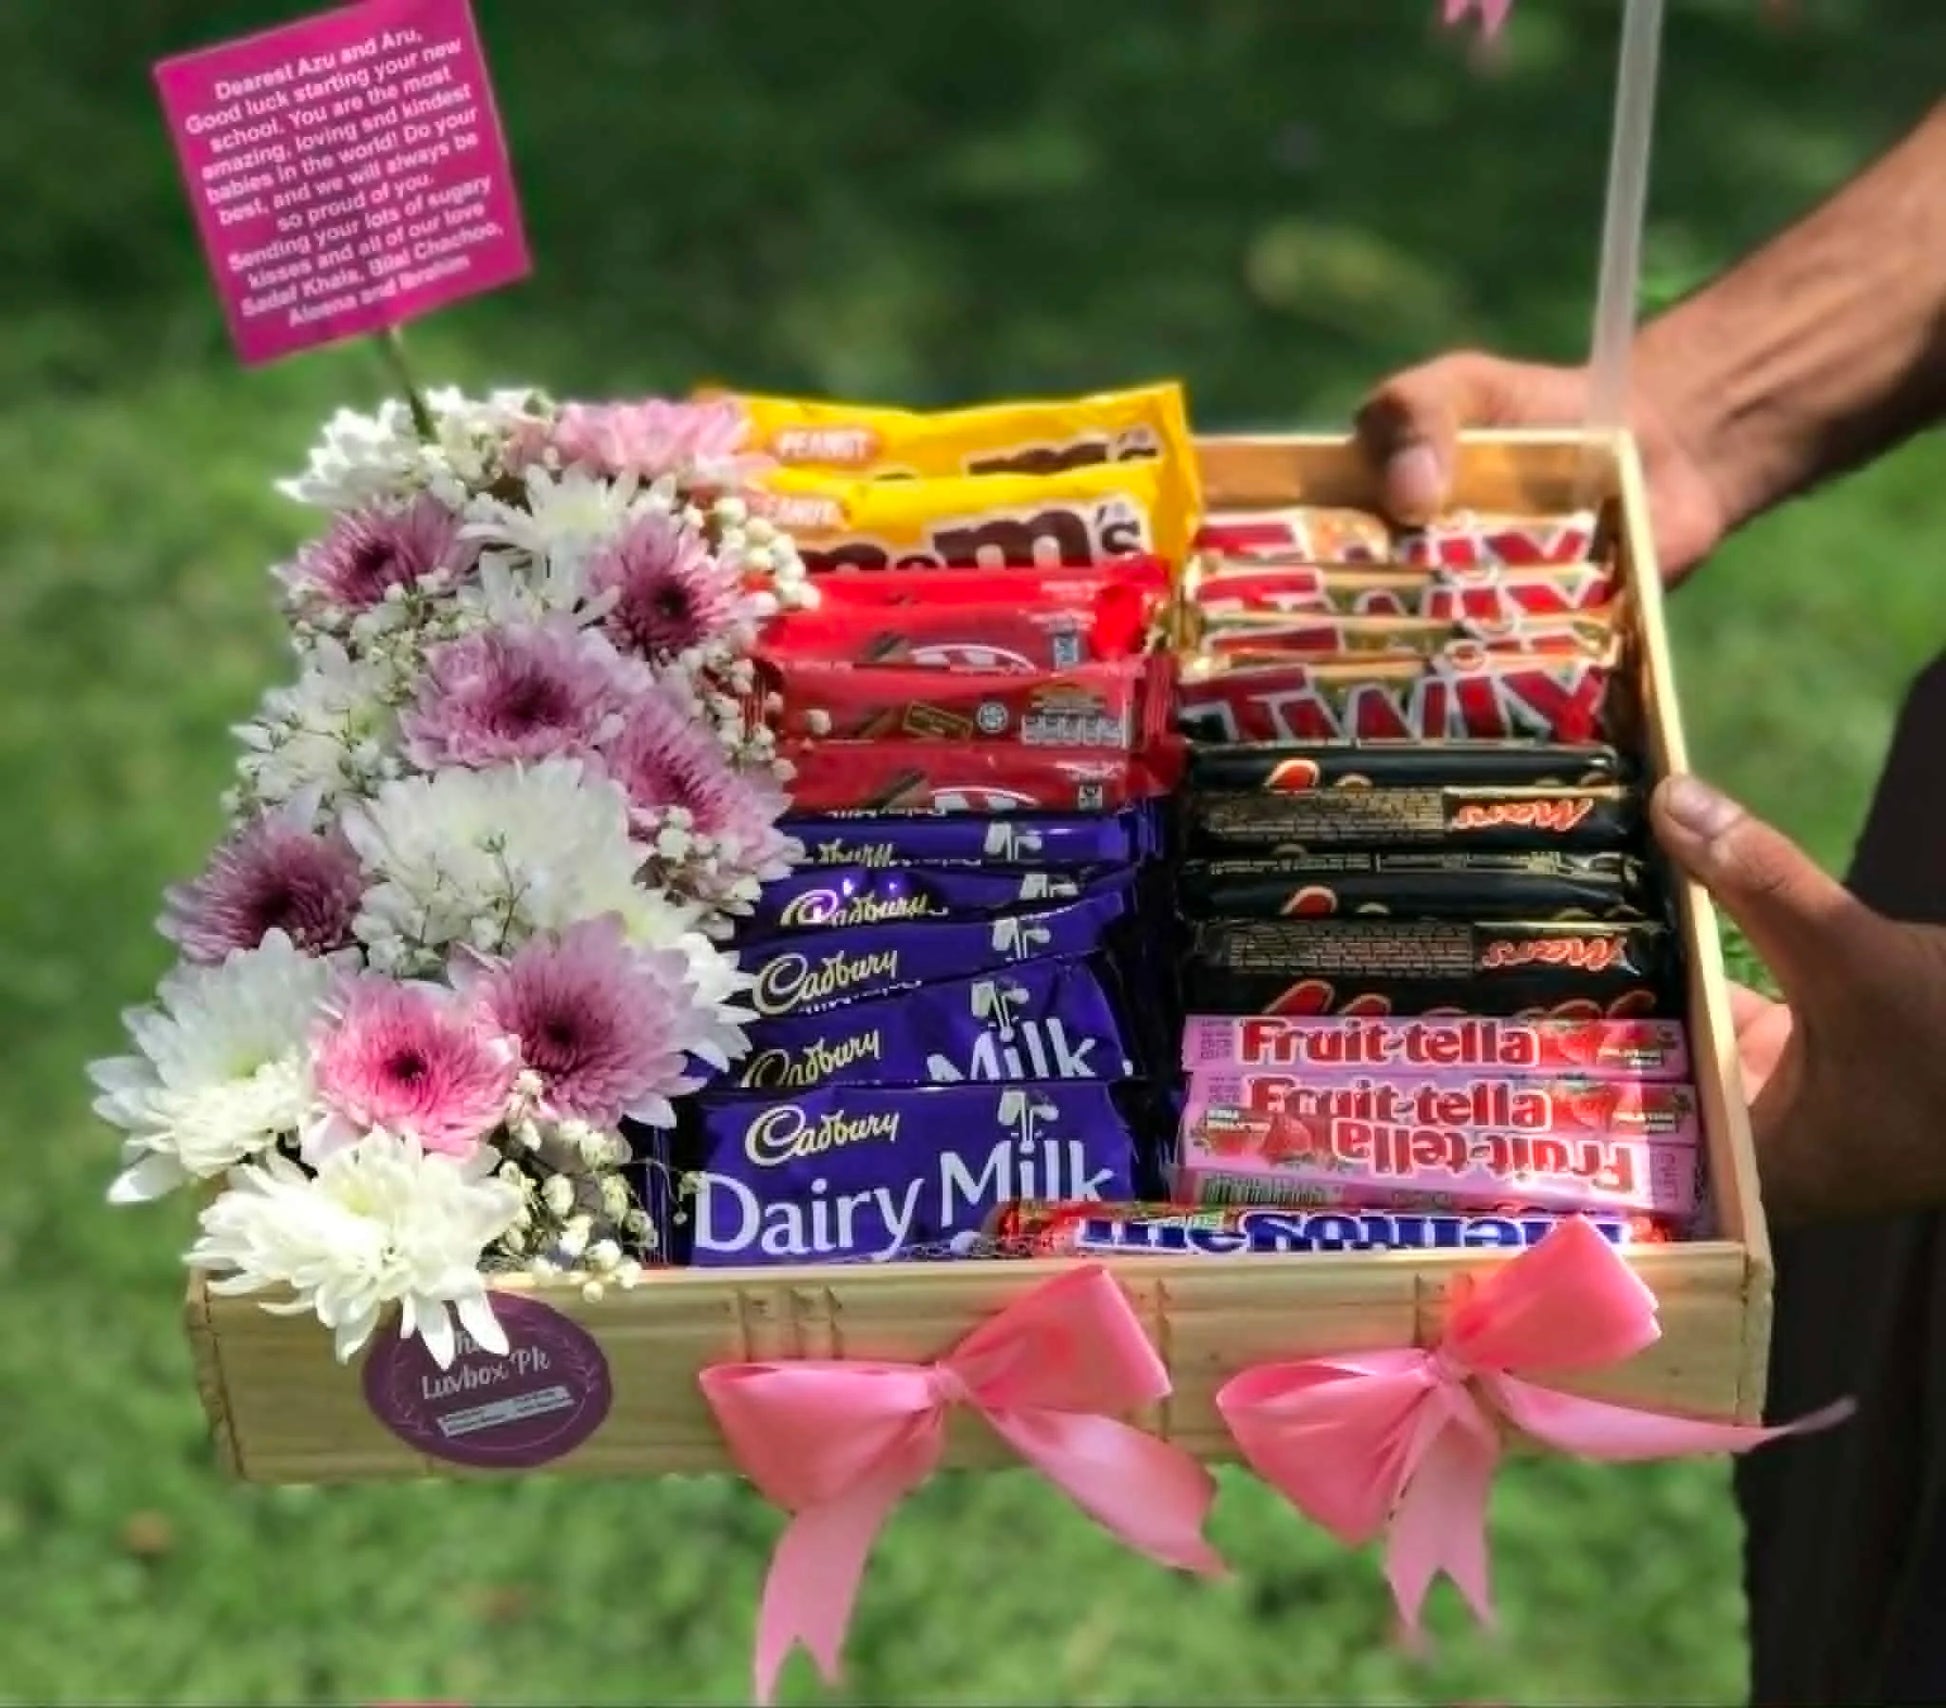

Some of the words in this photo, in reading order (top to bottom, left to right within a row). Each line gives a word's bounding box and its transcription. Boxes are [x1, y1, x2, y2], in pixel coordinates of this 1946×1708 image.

[185, 103, 242, 134] Good
[245, 90, 289, 115] luck
[293, 68, 370, 103] starting
[374, 52, 418, 83] your
[422, 38, 461, 62] new
[214, 63, 293, 100] Dearest
[341, 38, 377, 64] and
[289, 106, 327, 129] You
[332, 96, 363, 117] are
[366, 85, 398, 106] the
[403, 65, 452, 95] most
[202, 145, 292, 181] amazing,
[296, 123, 358, 153] loving
[361, 106, 398, 133] and
[402, 83, 471, 119] kindest
[206, 173, 274, 205] babies
[277, 164, 297, 182] in
[301, 154, 334, 175] the
[338, 131, 398, 164] world!
[403, 124, 431, 144] Do
[434, 107, 477, 138] your
[274, 182, 311, 209] and
[314, 177, 343, 196] we
[347, 160, 381, 186] will
[386, 142, 450, 174] always
[454, 132, 478, 151] be
[277, 213, 303, 232] so
[308, 190, 366, 227] proud
[370, 182, 390, 204] of
[394, 175, 434, 199] you.
[228, 236, 311, 272] Sending
[314, 220, 359, 247] your
[365, 208, 399, 229] lots
[405, 194, 423, 217] of
[248, 259, 312, 289] kisses
[317, 243, 354, 269] and
[359, 235, 382, 257] all
[385, 225, 404, 247] of
[408, 216, 440, 238] our
[443, 202, 485, 227] love
[752, 949, 898, 1015] Cadbury
[741, 1029, 880, 1087] Cadbury
[927, 1017, 1097, 1079] Milk
[1242, 1018, 1537, 1065] Fruit-tella
[745, 1105, 900, 1166] Cadbury
[1335, 1120, 1635, 1193] Fruit-tella
[694, 1171, 925, 1260] Dairy
[940, 1139, 1115, 1228] Milk
[421, 1360, 508, 1399] Luvbox
